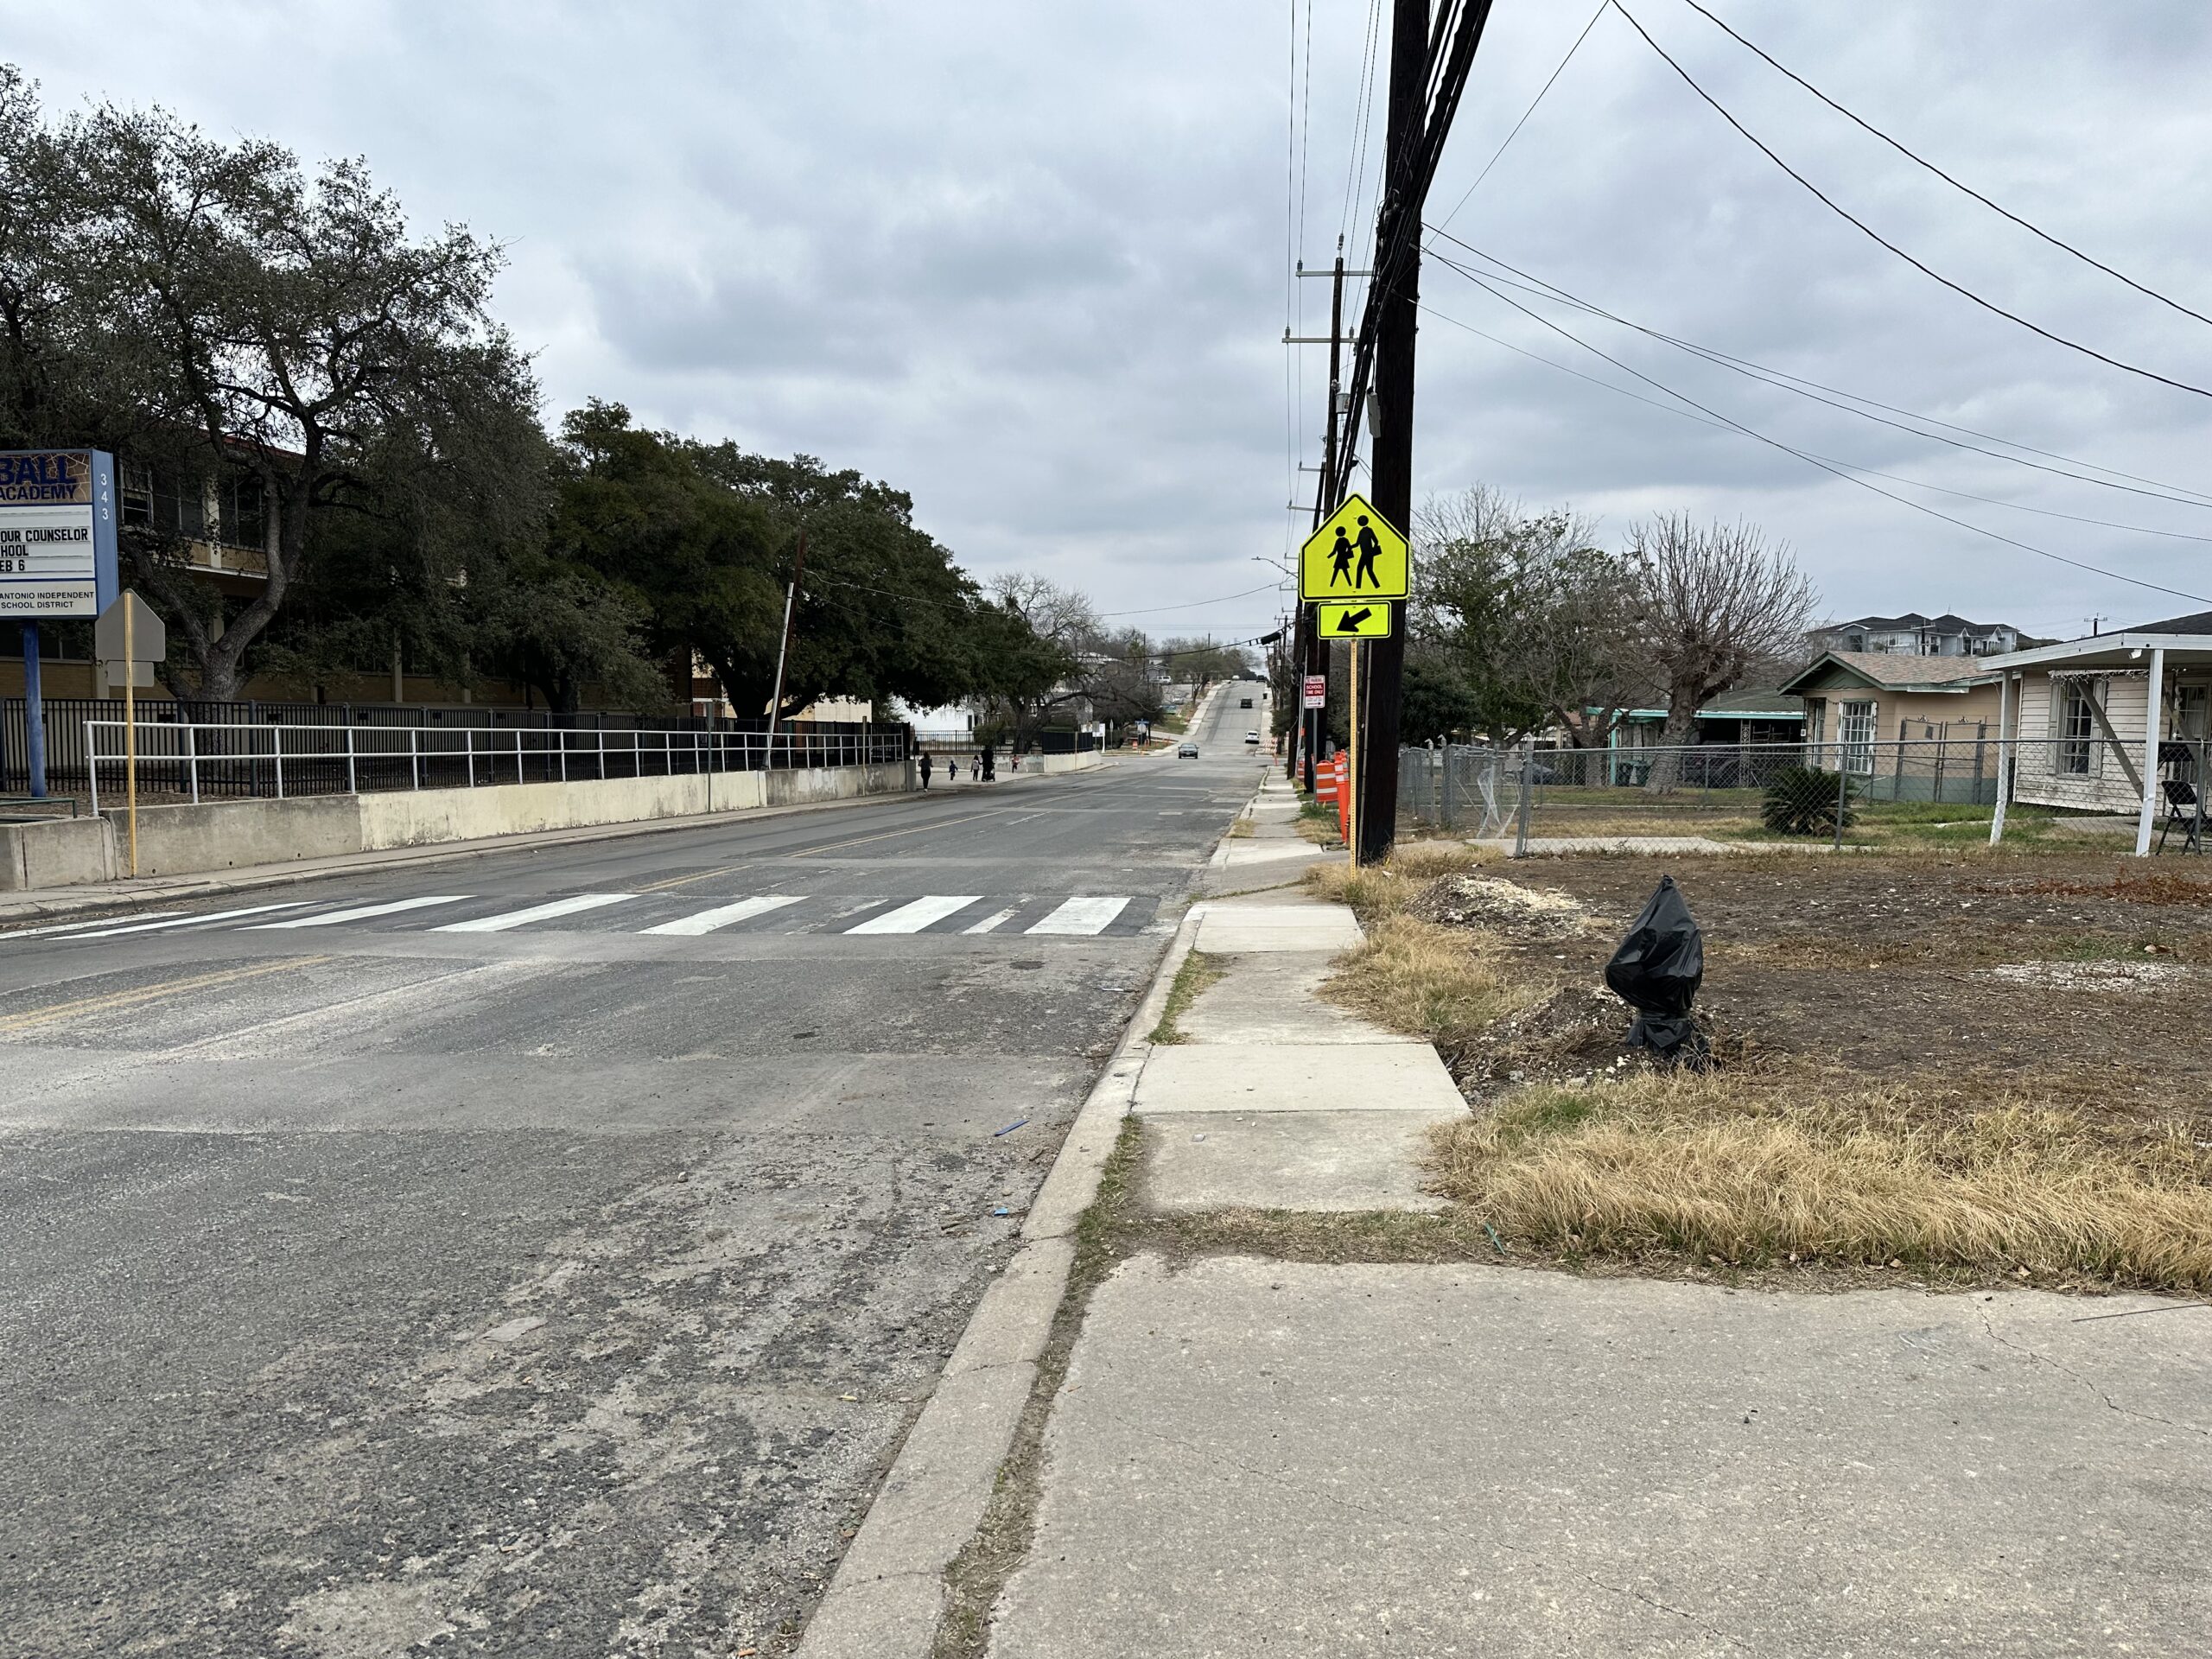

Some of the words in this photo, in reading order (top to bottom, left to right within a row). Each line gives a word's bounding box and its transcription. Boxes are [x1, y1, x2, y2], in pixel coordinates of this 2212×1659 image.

[0, 455, 77, 485] BALL
[25, 528, 88, 542] COUNSELOR
[18, 559, 25, 571] 6
